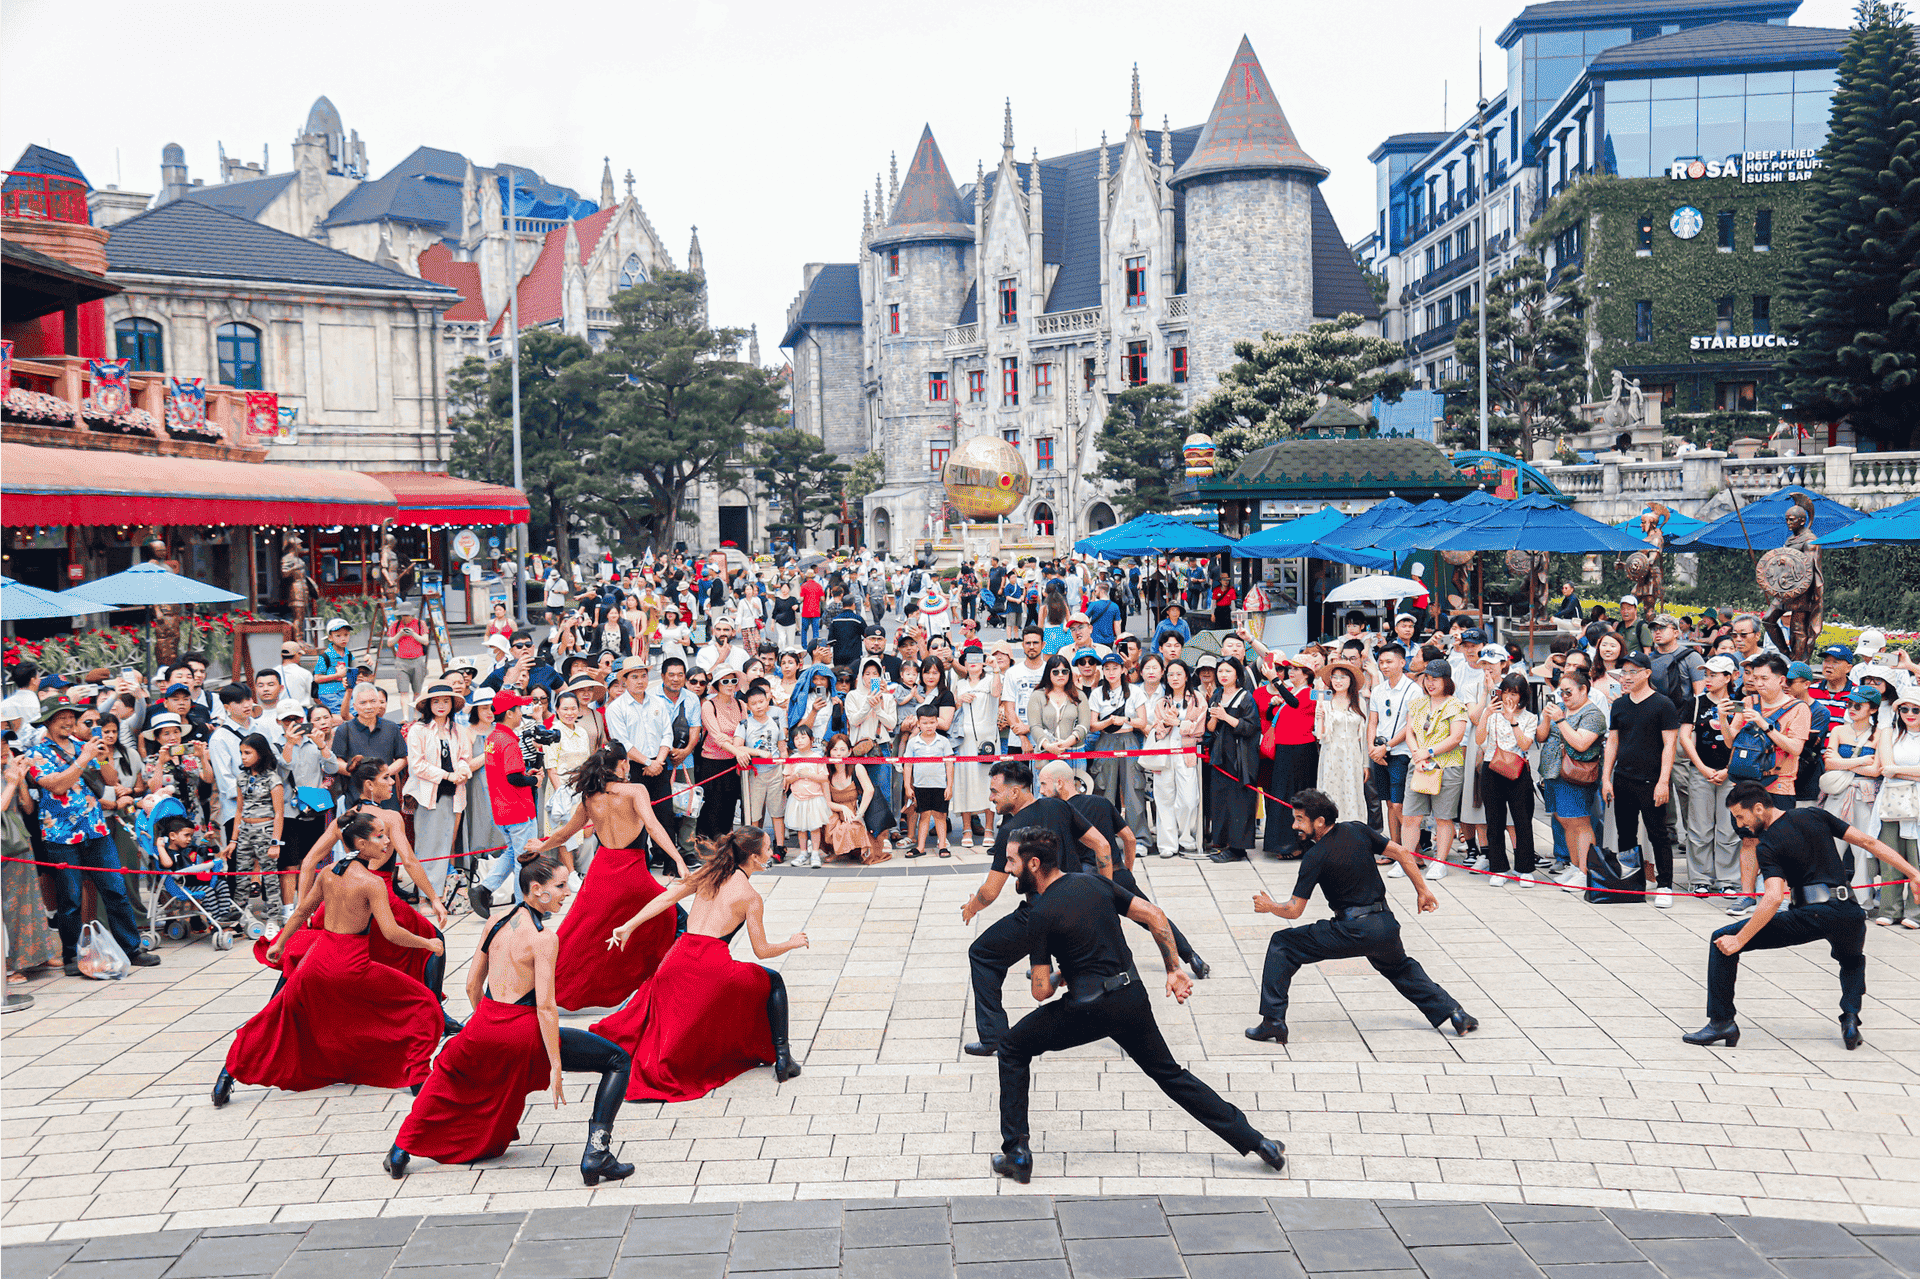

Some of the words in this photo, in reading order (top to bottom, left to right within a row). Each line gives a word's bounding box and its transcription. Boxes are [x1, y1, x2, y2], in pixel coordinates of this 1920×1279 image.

[1746, 150, 1777, 161] DEEP
[1781, 149, 1815, 159] FRIED
[1671, 160, 1738, 180] ROSA
[1746, 162, 1770, 172] HOT
[1771, 161, 1793, 171] POT
[1746, 172, 1782, 184] SUSHI
[1788, 171, 1813, 182] BAR
